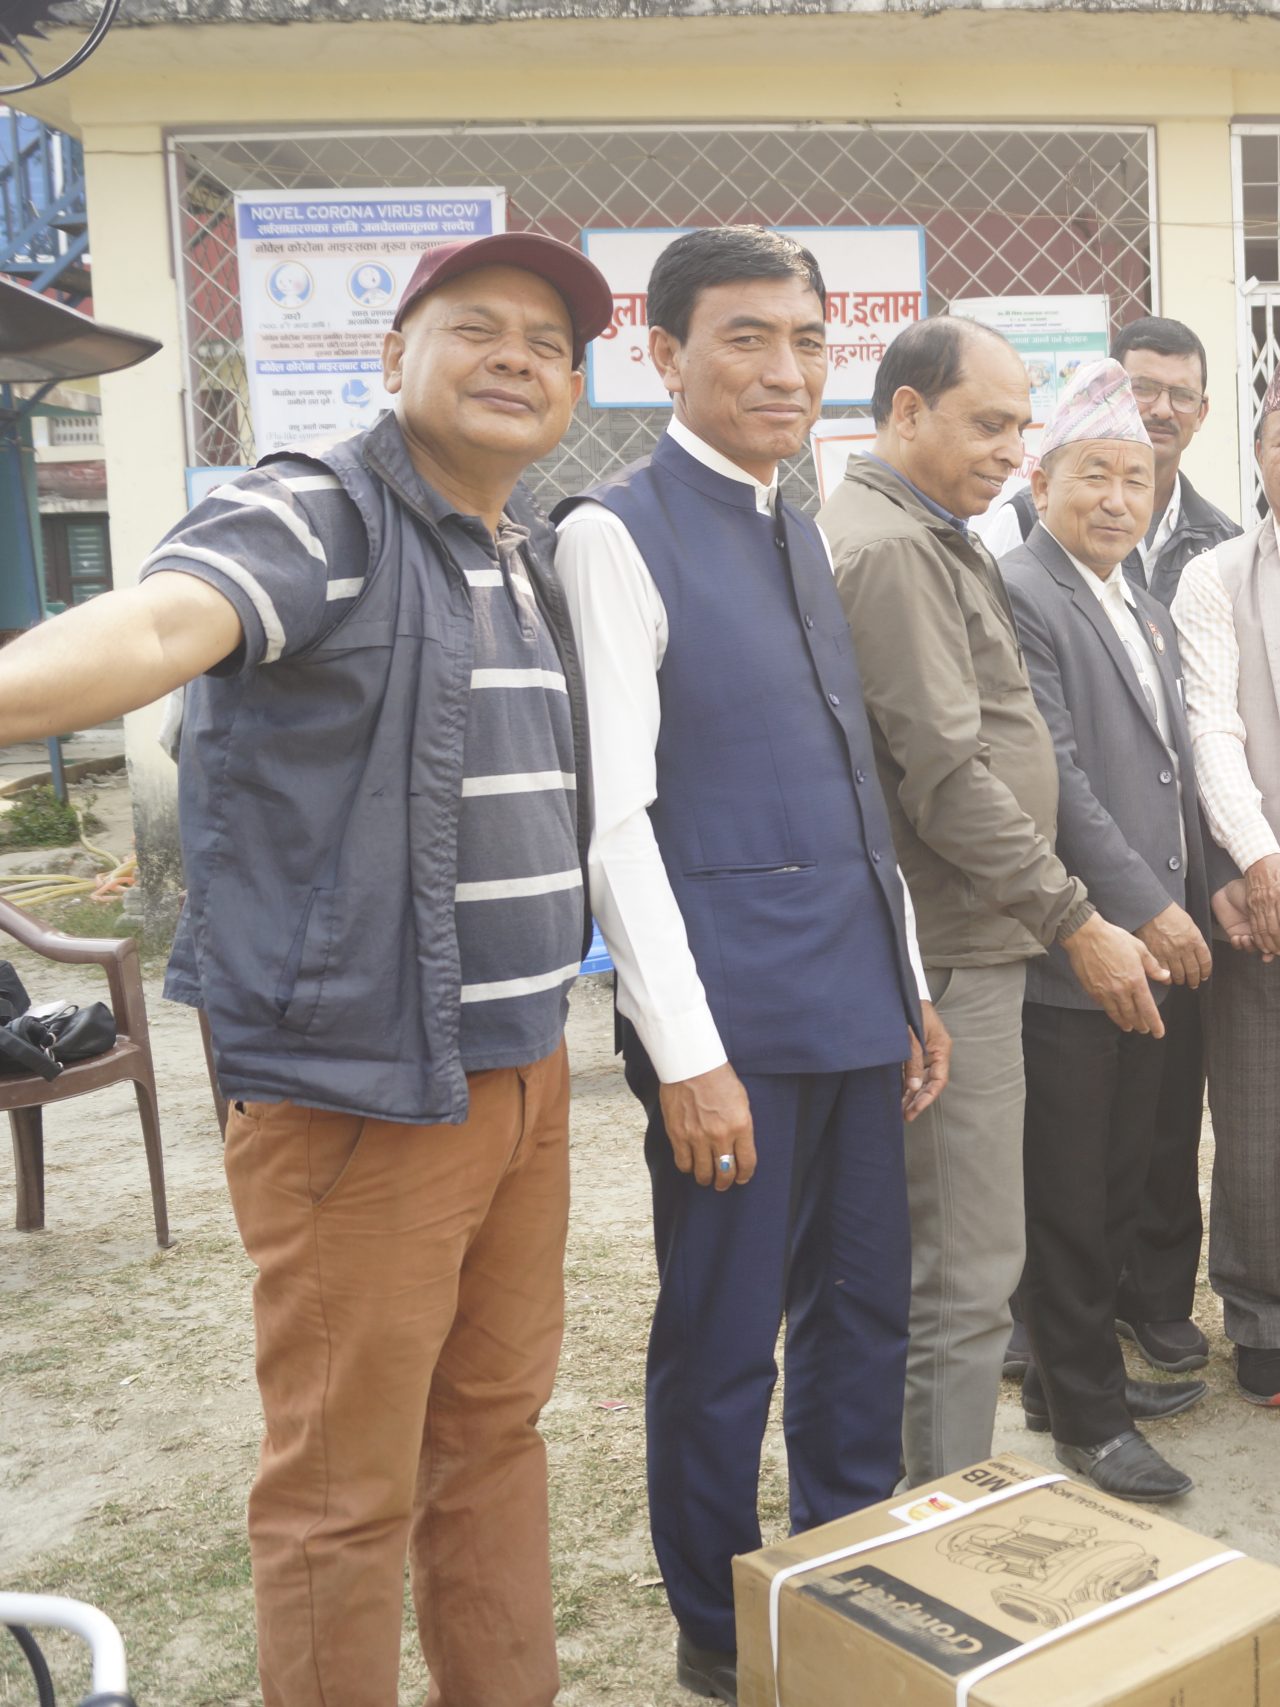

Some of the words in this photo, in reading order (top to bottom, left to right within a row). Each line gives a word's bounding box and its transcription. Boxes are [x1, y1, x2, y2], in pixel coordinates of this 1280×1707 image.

[251, 206, 304, 220] NOVEL
[306, 205, 374, 219] CORONA
[378, 204, 423, 218] VIRUS
[426, 203, 479, 218] (NCOV)
[1076, 1493, 1153, 1531] CENTRIFUGAL
[850, 1576, 984, 1656] Crompton
